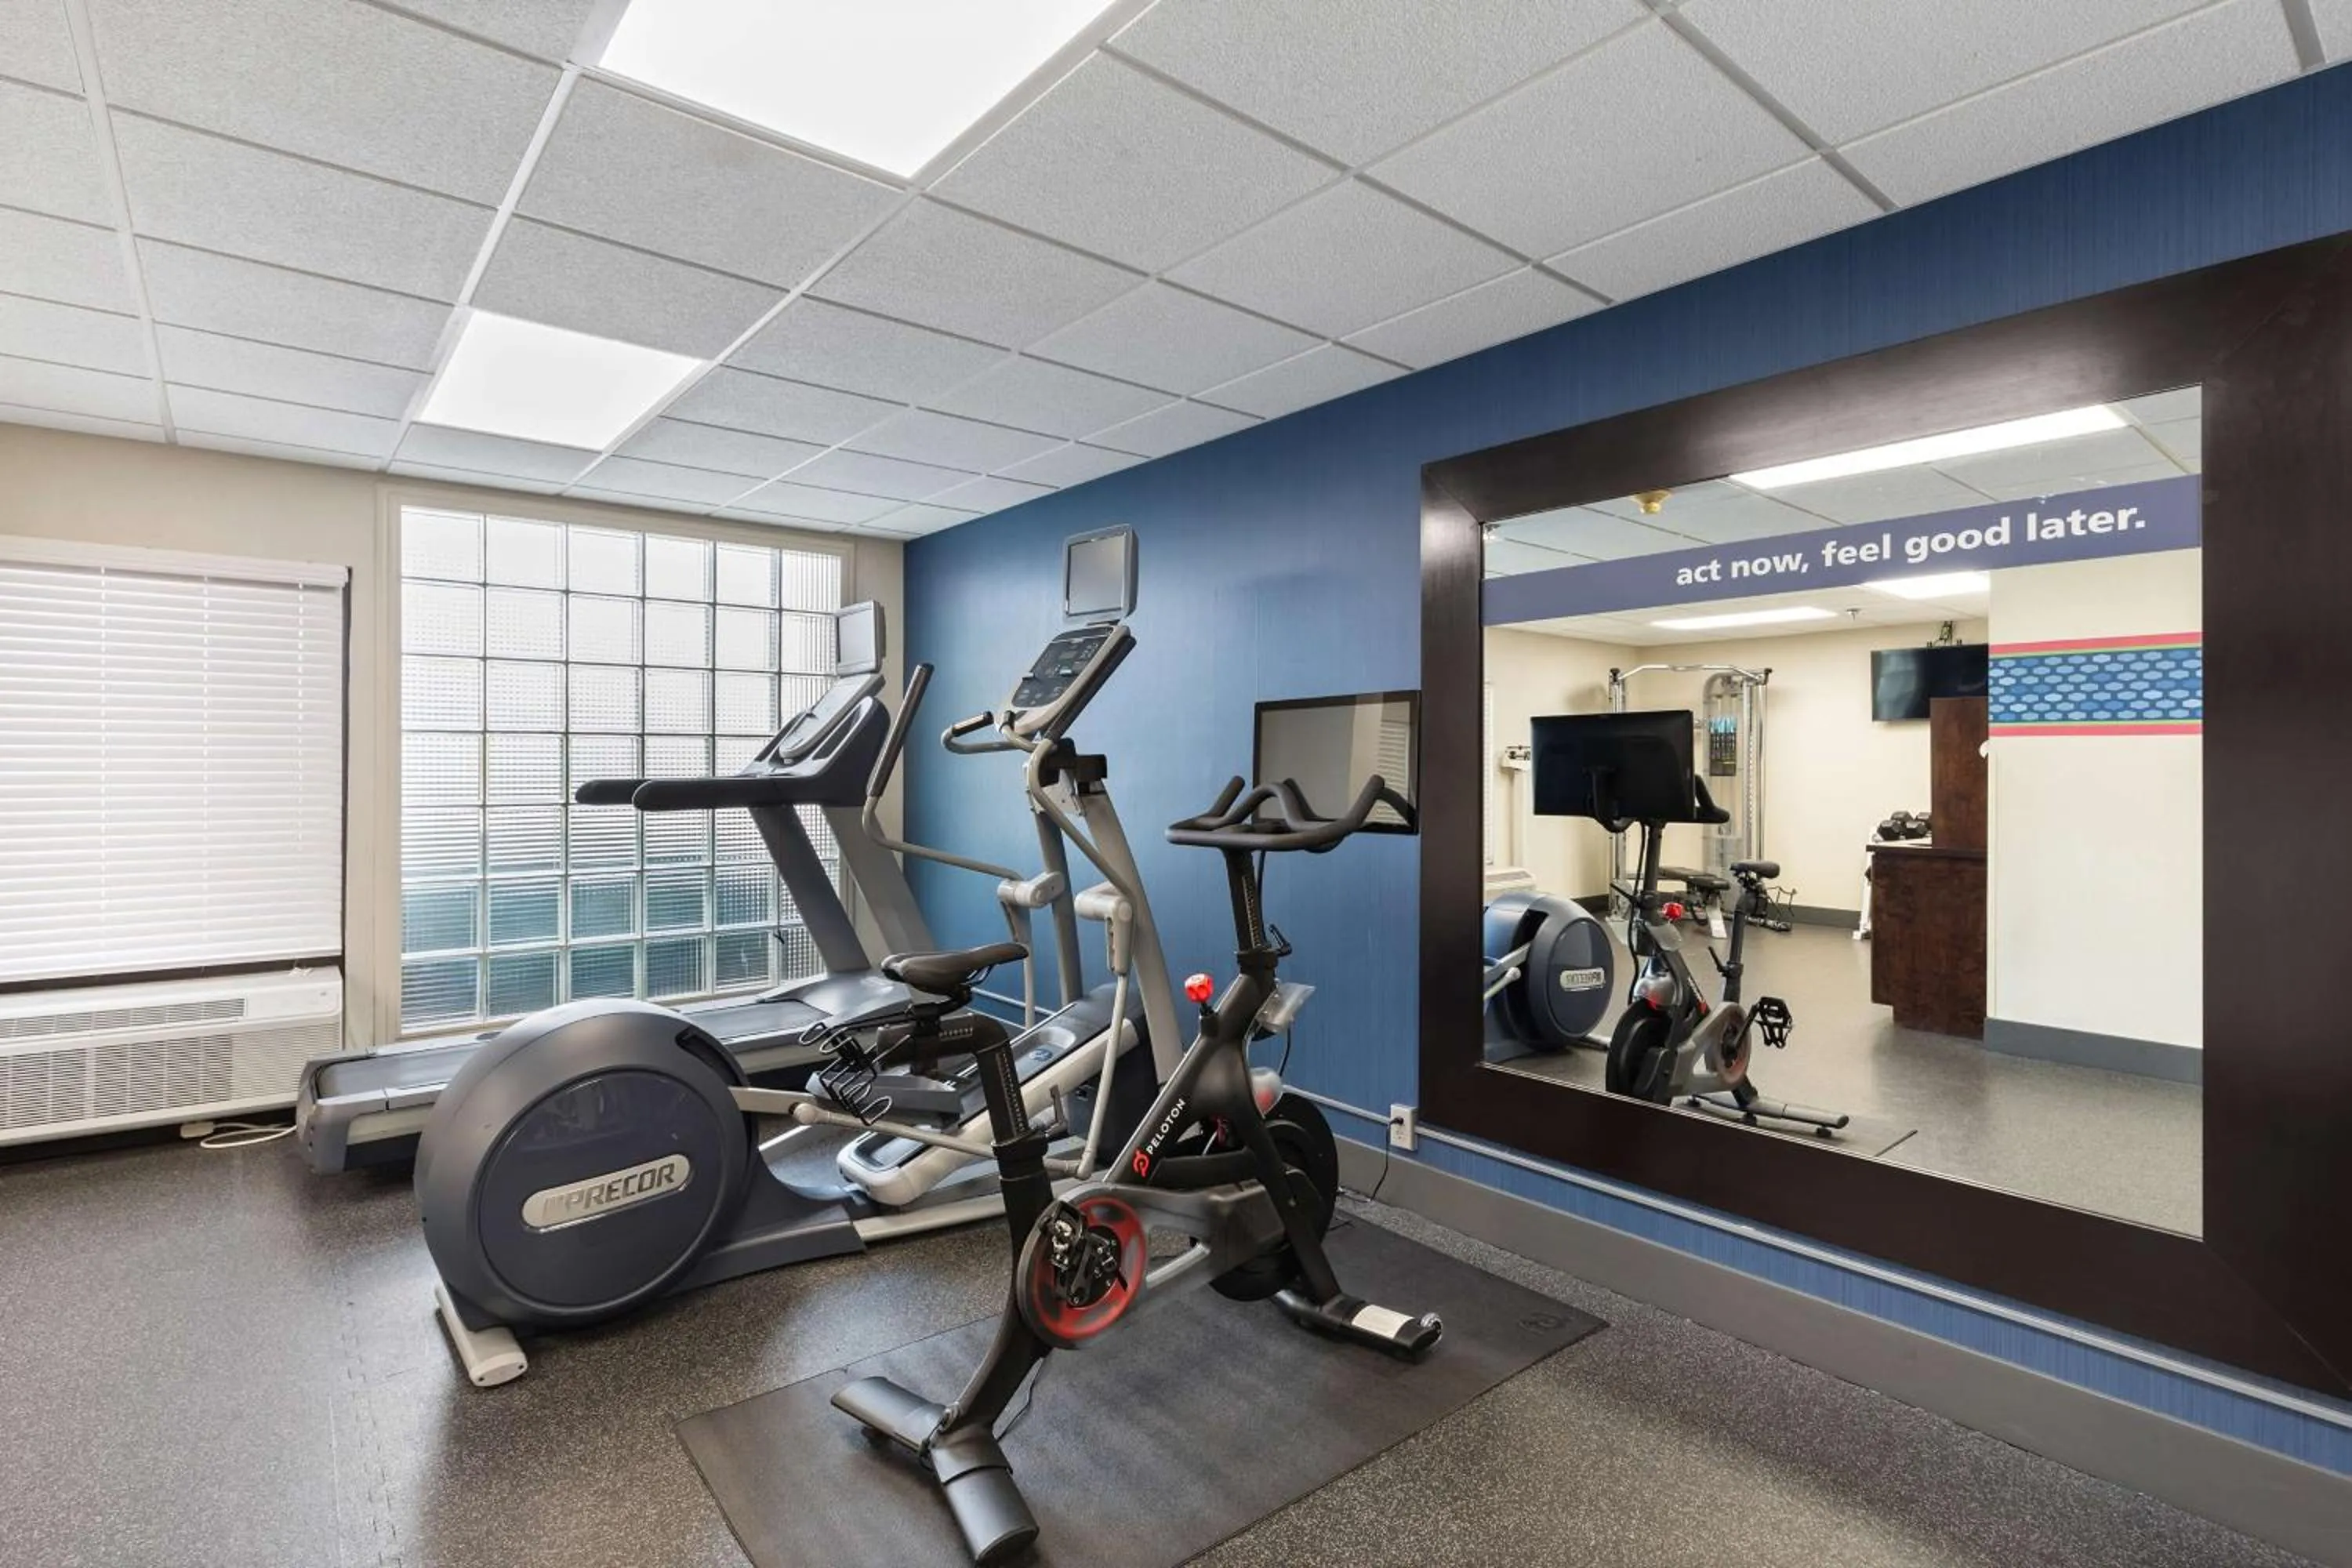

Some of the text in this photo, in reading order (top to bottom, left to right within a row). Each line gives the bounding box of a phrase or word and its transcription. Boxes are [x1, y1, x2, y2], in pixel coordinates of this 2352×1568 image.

[1676, 503, 2146, 586] act now, feel good later.
[1145, 1098, 1186, 1155] PELOTON
[563, 1163, 675, 1212] PRECOR
